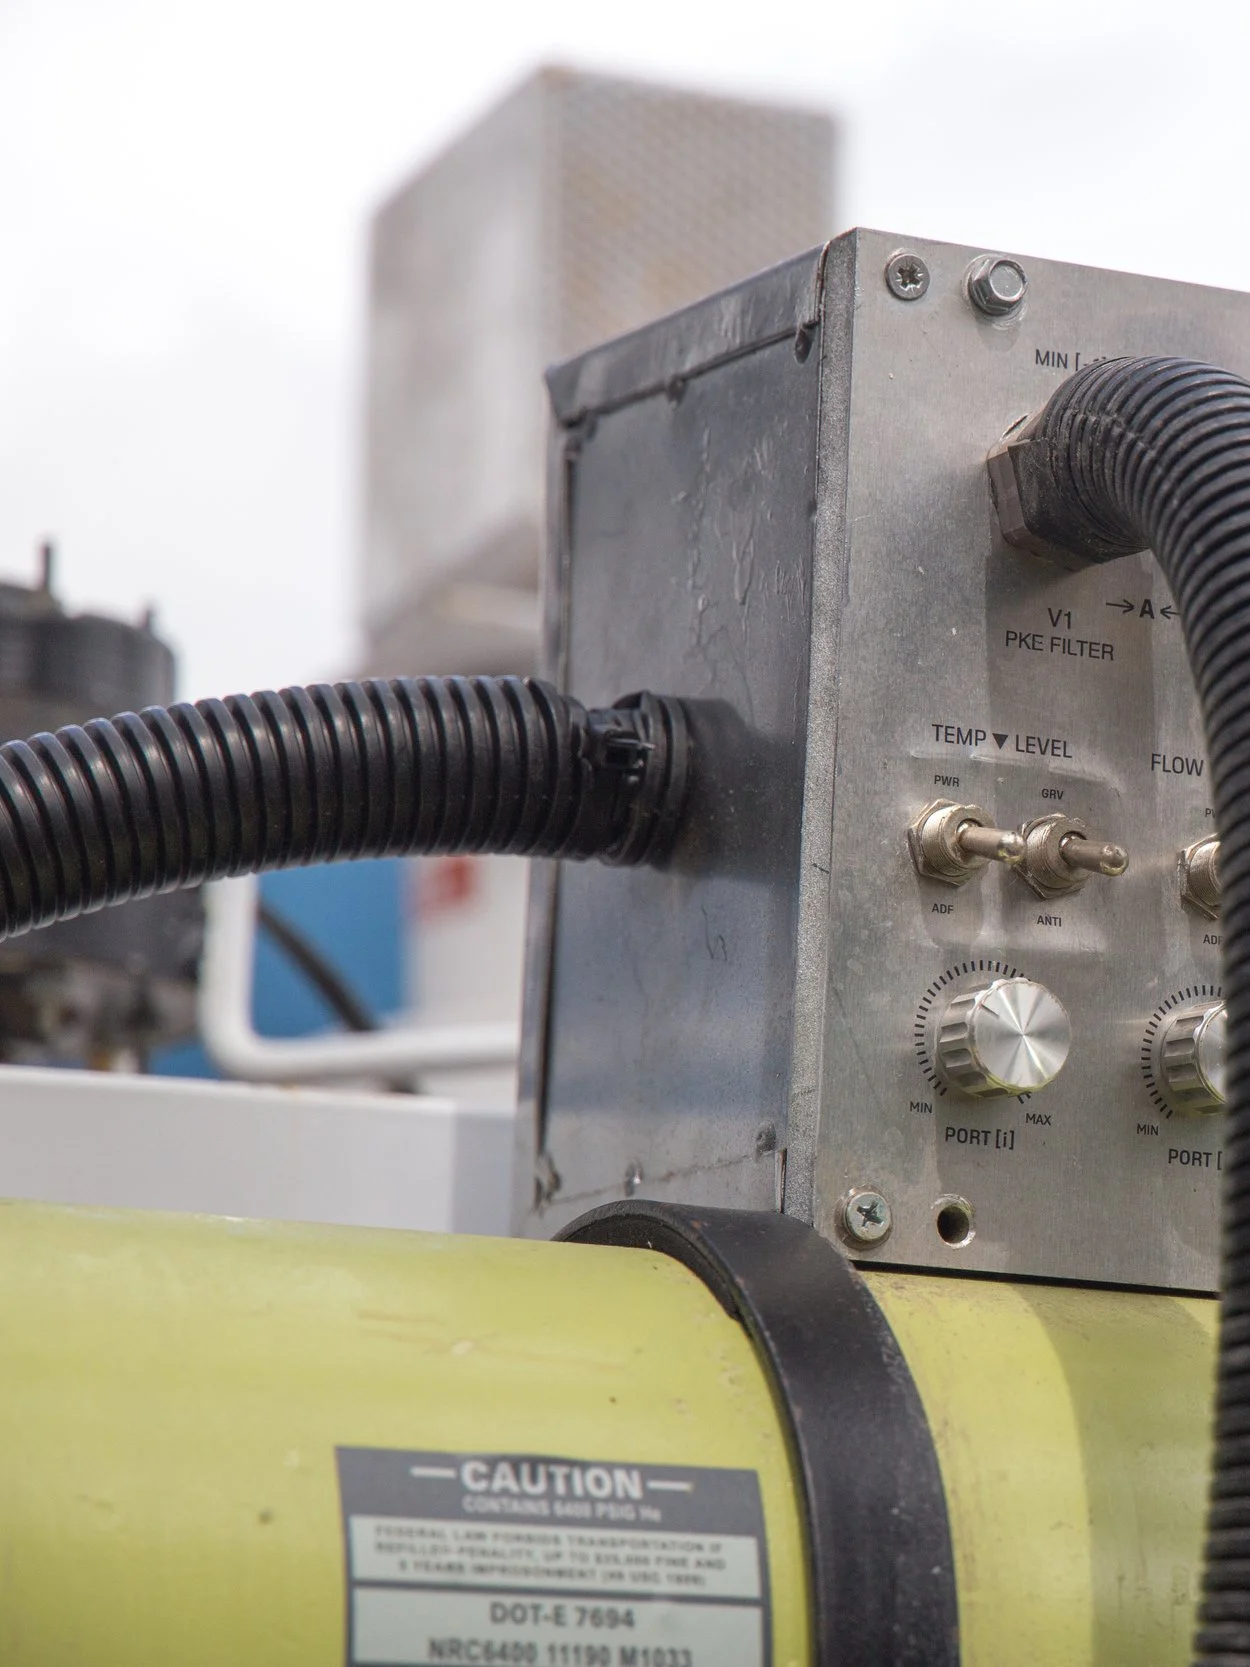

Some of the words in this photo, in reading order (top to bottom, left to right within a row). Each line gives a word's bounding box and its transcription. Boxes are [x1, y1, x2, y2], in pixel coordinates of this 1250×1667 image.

[1035, 349, 1068, 369] MIN
[1048, 608, 1072, 630] V1
[1139, 599, 1155, 619] A
[1006, 631, 1044, 651] PKE
[1050, 636, 1115, 661] FILTER
[931, 724, 987, 747] TEMP
[1015, 734, 1073, 759] LEVEL
[1151, 754, 1204, 777] FLOW
[934, 775, 960, 787] PWR
[1041, 788, 1064, 800] GRV
[931, 903, 954, 915] ADF
[1037, 915, 1062, 928] ANTI
[909, 1101, 933, 1114] MIN
[1025, 1113, 1052, 1126] MAX
[1137, 1123, 1159, 1136] MIN
[945, 1126, 990, 1146] PORT
[995, 1130, 1015, 1150] [i]
[1168, 1148, 1213, 1168] PORT
[461, 1461, 643, 1499] CAUTION
[461, 1494, 550, 1517] CONTAINS
[595, 1503, 635, 1522] PSIG
[490, 1601, 567, 1627] DOT-E
[575, 1604, 636, 1630] 7694
[427, 1636, 539, 1662] NRC6400
[547, 1642, 613, 1667] 11190
[619, 1644, 694, 1667] M1033
